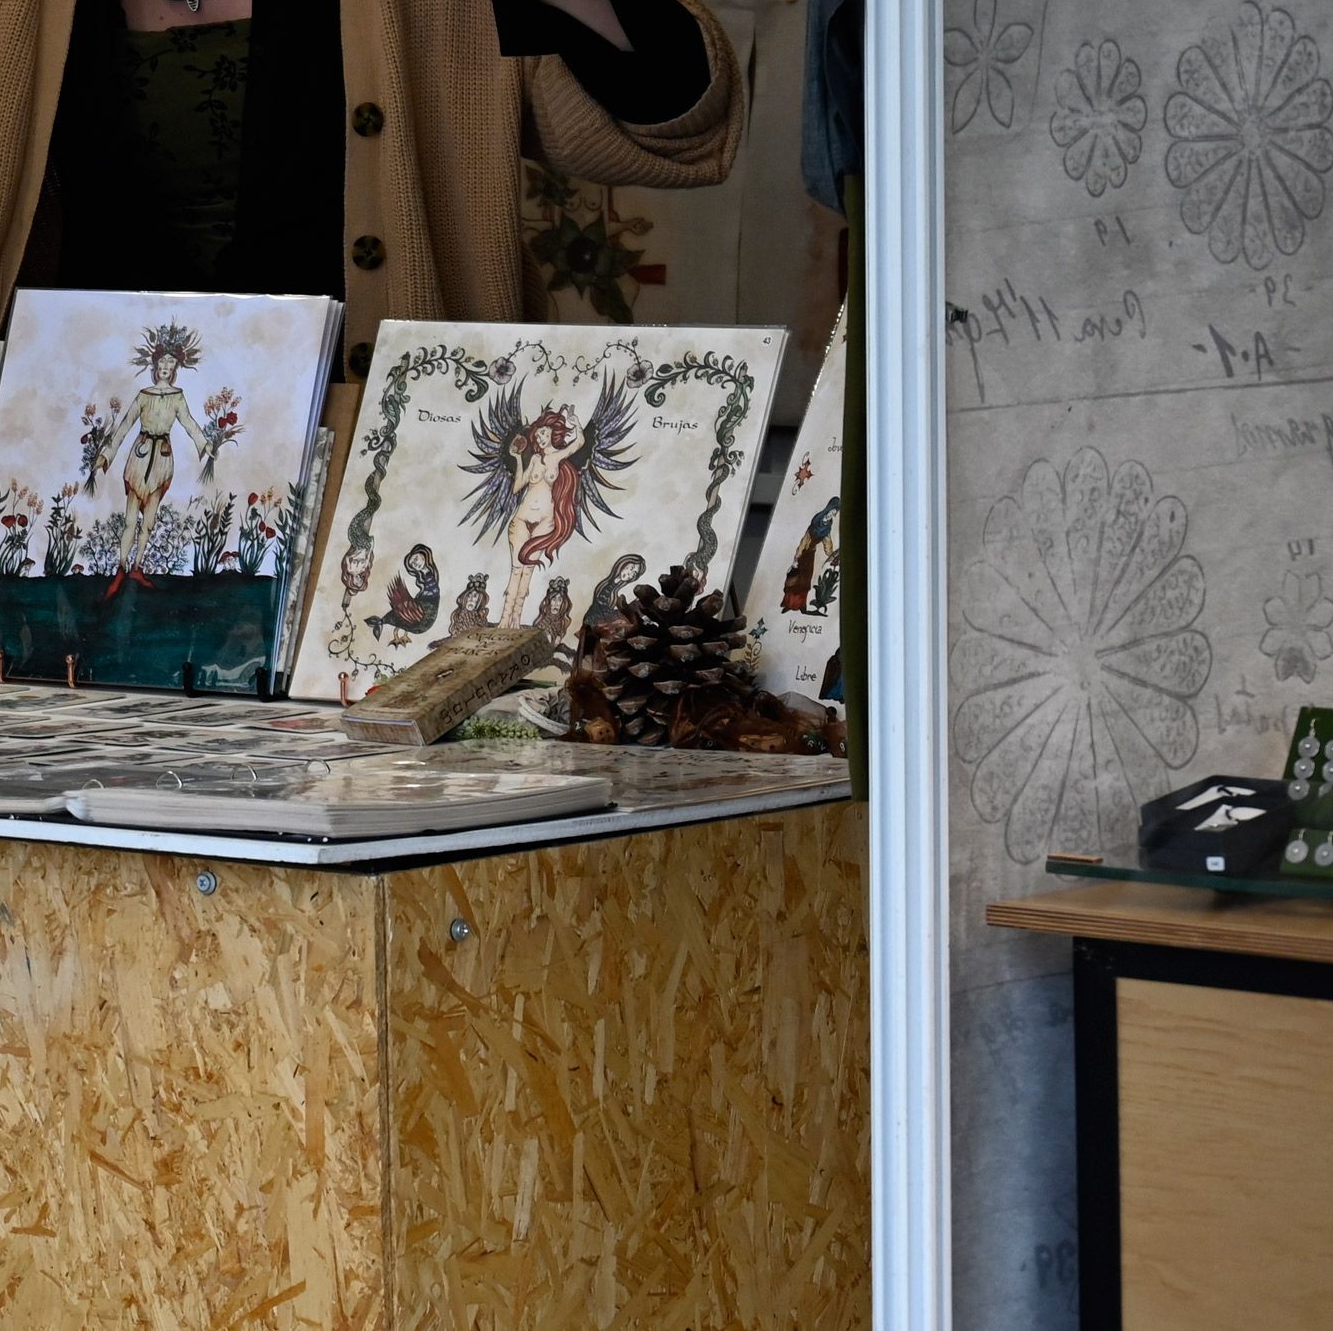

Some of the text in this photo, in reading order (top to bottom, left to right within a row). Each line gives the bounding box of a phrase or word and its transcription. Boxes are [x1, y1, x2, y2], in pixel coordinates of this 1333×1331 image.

[418, 409, 462, 423] Diosas
[652, 416, 698, 434] Brujas
[795, 665, 817, 682] Libre
